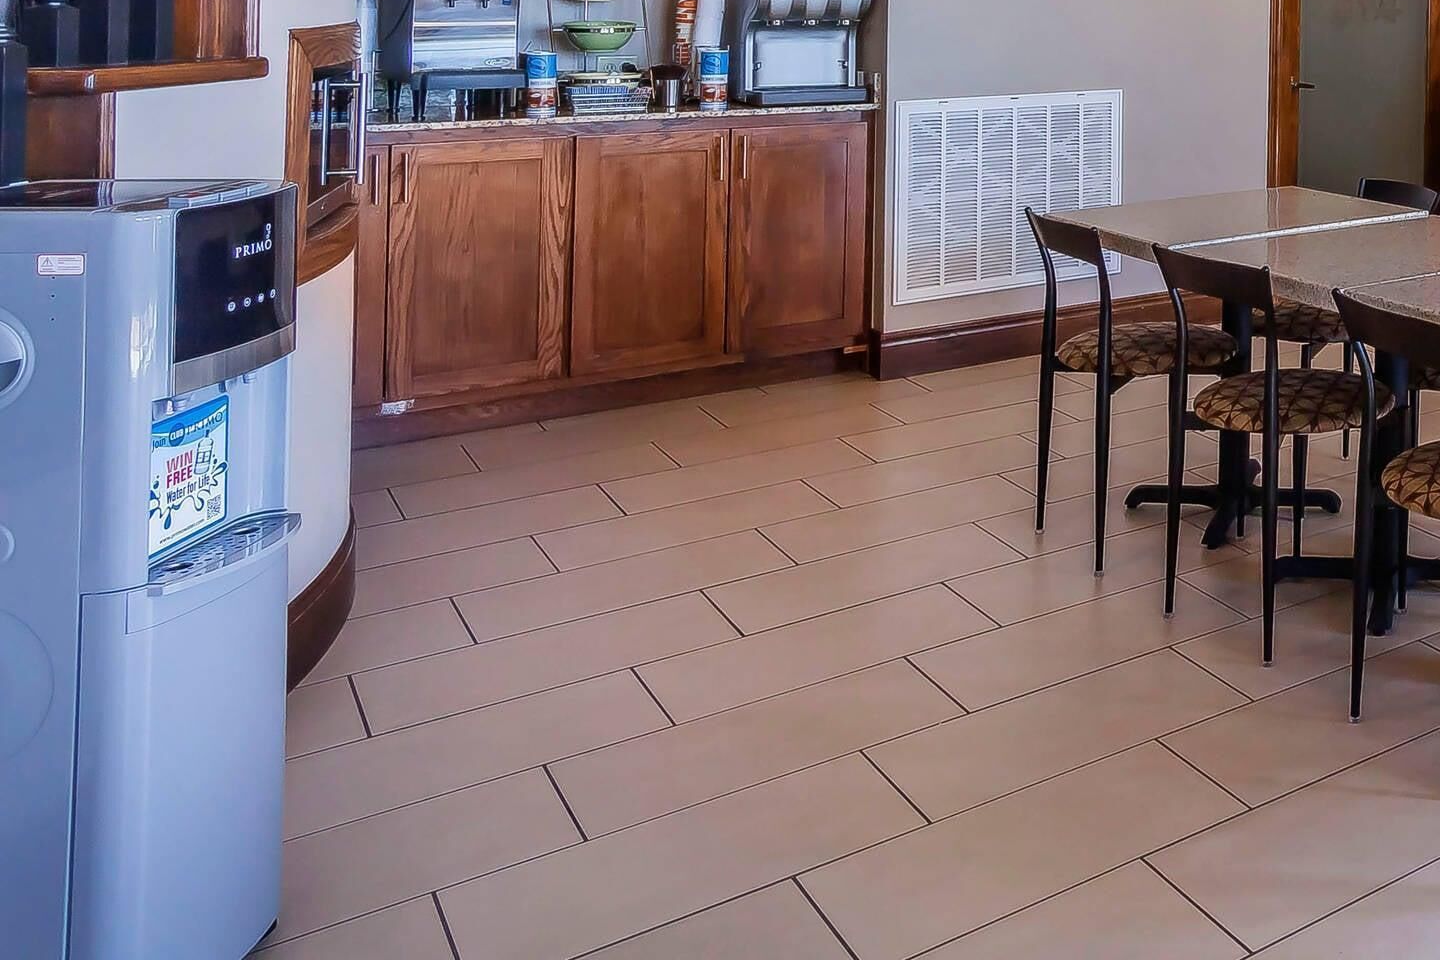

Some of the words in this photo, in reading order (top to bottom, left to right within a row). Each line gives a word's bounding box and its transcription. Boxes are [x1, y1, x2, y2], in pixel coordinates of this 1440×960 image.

[235, 239, 273, 259] PRIMO
[169, 427, 184, 441] CLUB
[166, 450, 193, 473] WIN
[166, 464, 193, 489] FREE
[166, 485, 186, 505] Water
[187, 480, 198, 494] for
[198, 474, 211, 490] Life
